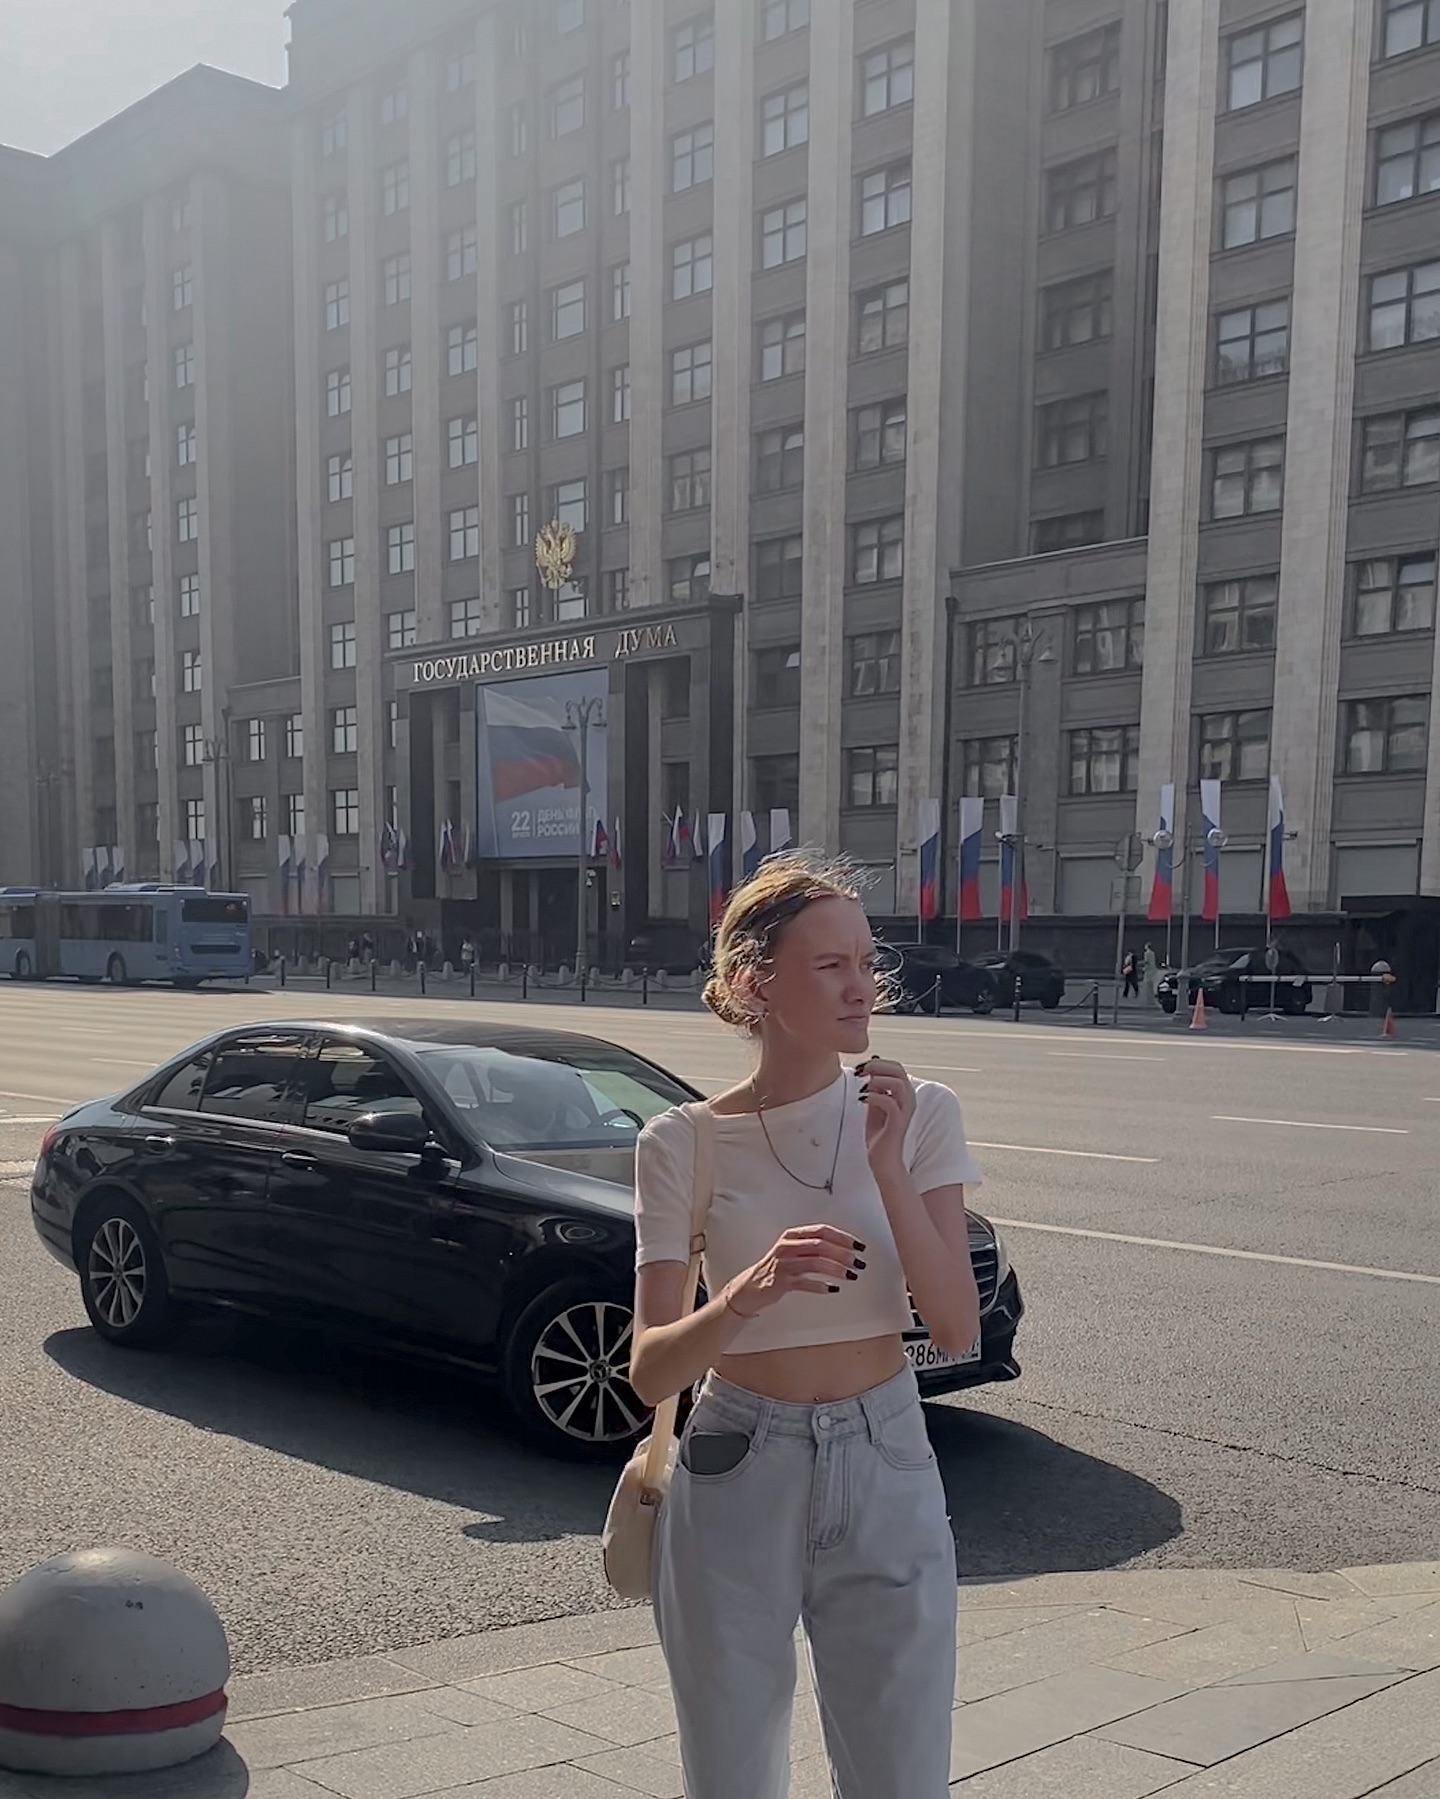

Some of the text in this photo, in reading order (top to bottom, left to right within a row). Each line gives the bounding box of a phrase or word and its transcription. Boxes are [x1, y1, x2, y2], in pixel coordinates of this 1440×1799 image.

[413, 624, 678, 683] ГОСУДАРСТВЕННАЯ ДУМА
[511, 810, 531, 832] 22
